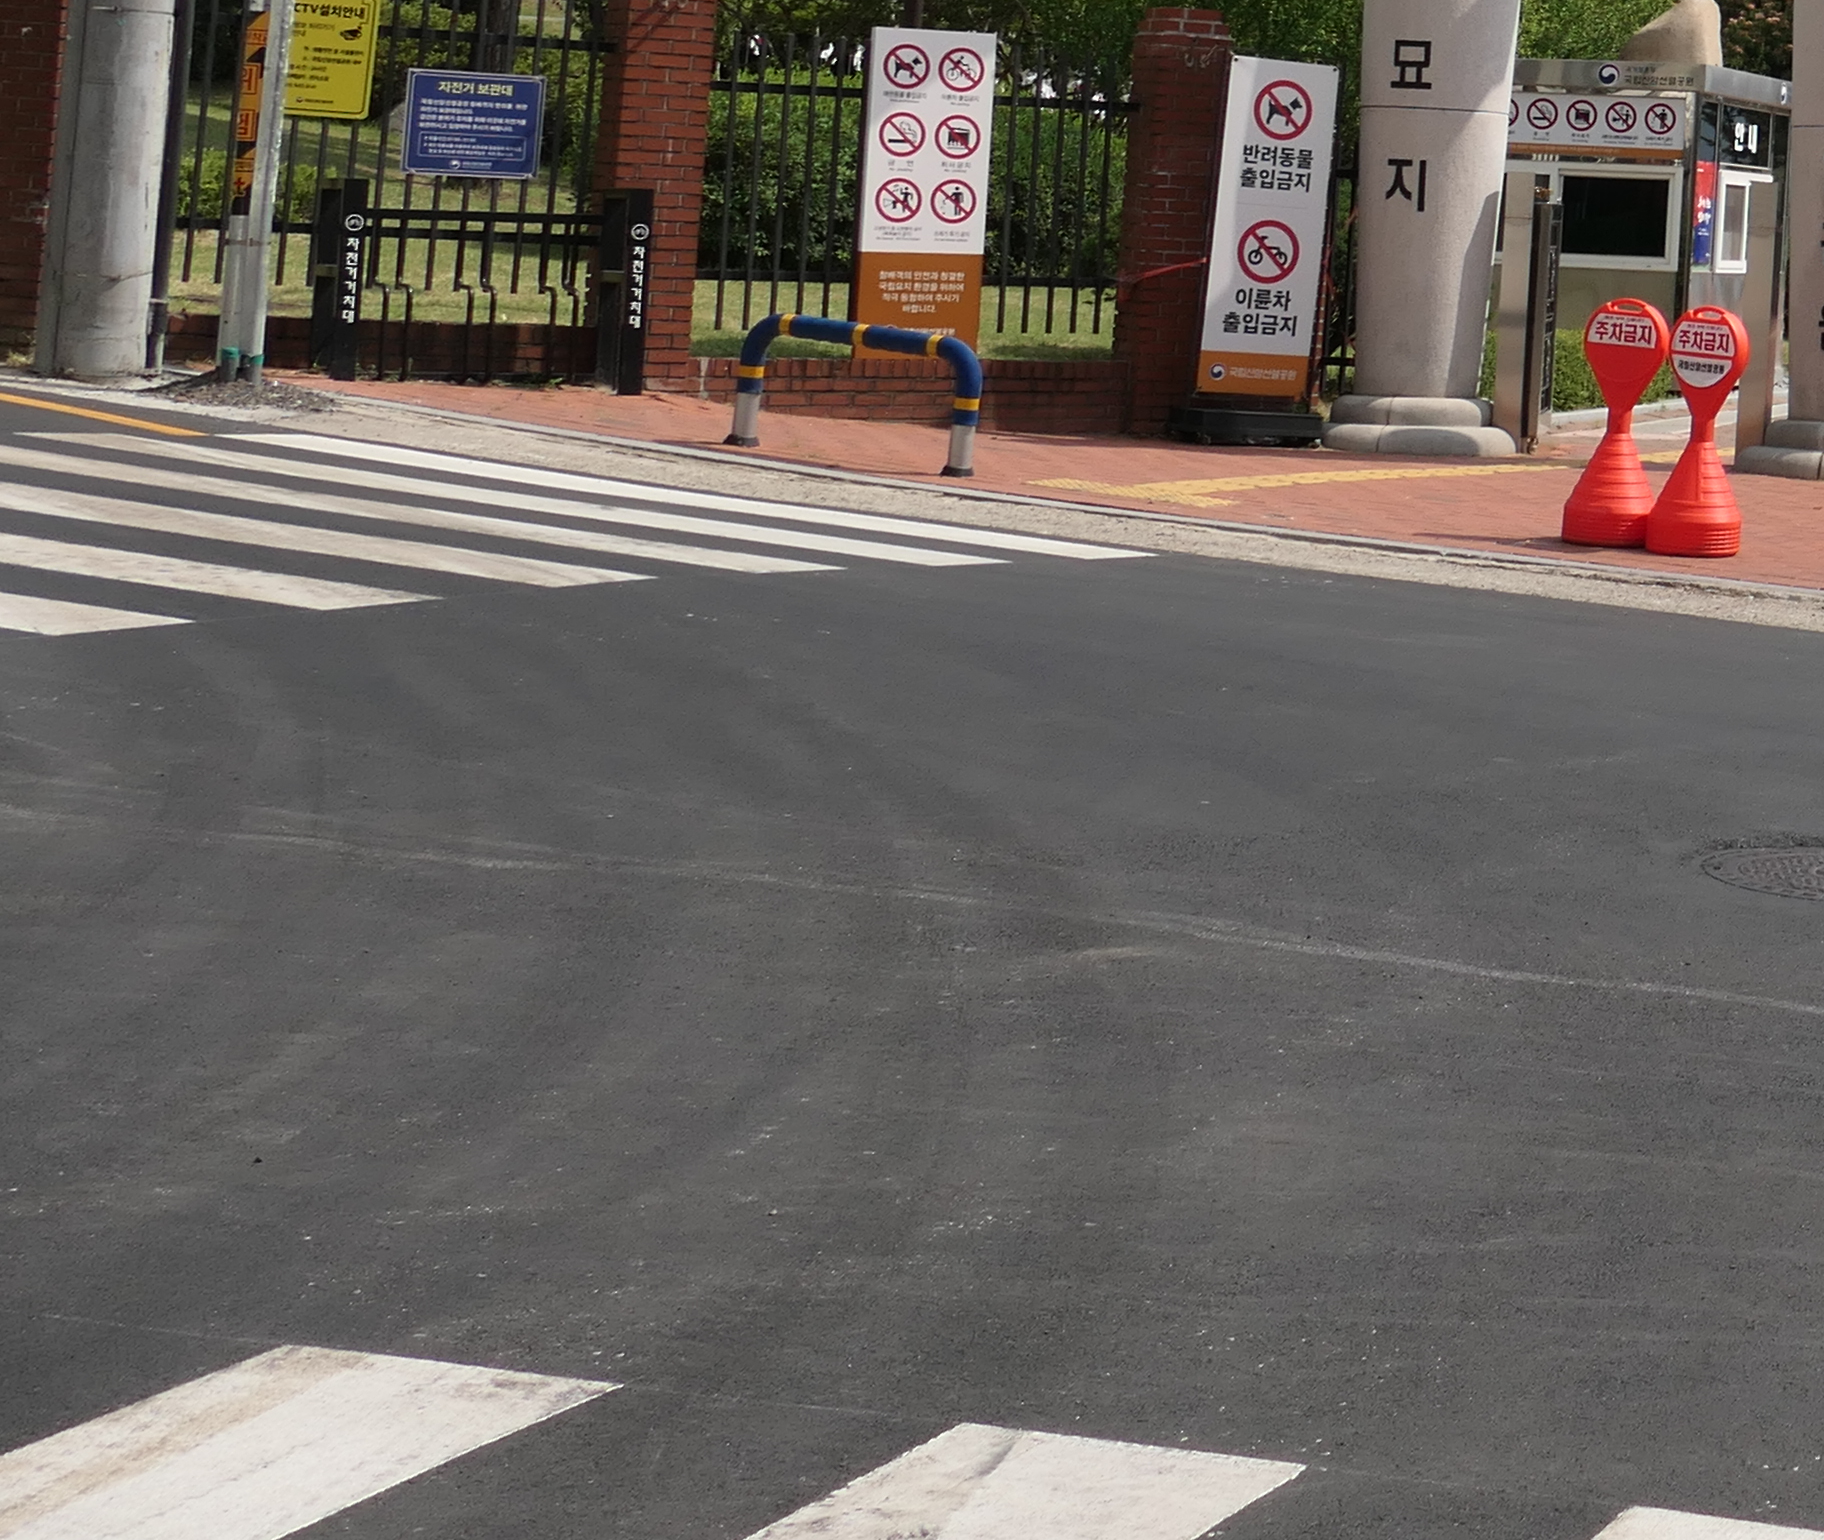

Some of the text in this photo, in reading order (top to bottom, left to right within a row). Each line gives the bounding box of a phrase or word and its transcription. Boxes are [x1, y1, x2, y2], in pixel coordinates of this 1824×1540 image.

[292, 2, 366, 20] CTV설치안내
[438, 81, 514, 96] 자전거 보관대
[1733, 121, 1759, 154] 안내
[1242, 144, 1314, 170] 반려동물
[1239, 167, 1312, 193] 출입금지
[341, 237, 360, 324] 자전거거치대
[628, 245, 646, 329] 자전거거치대
[1235, 287, 1292, 312] 이륜차
[1222, 312, 1298, 337] 출입금지
[1594, 321, 1653, 345] 주차금지
[1678, 329, 1730, 353] 주차금지
